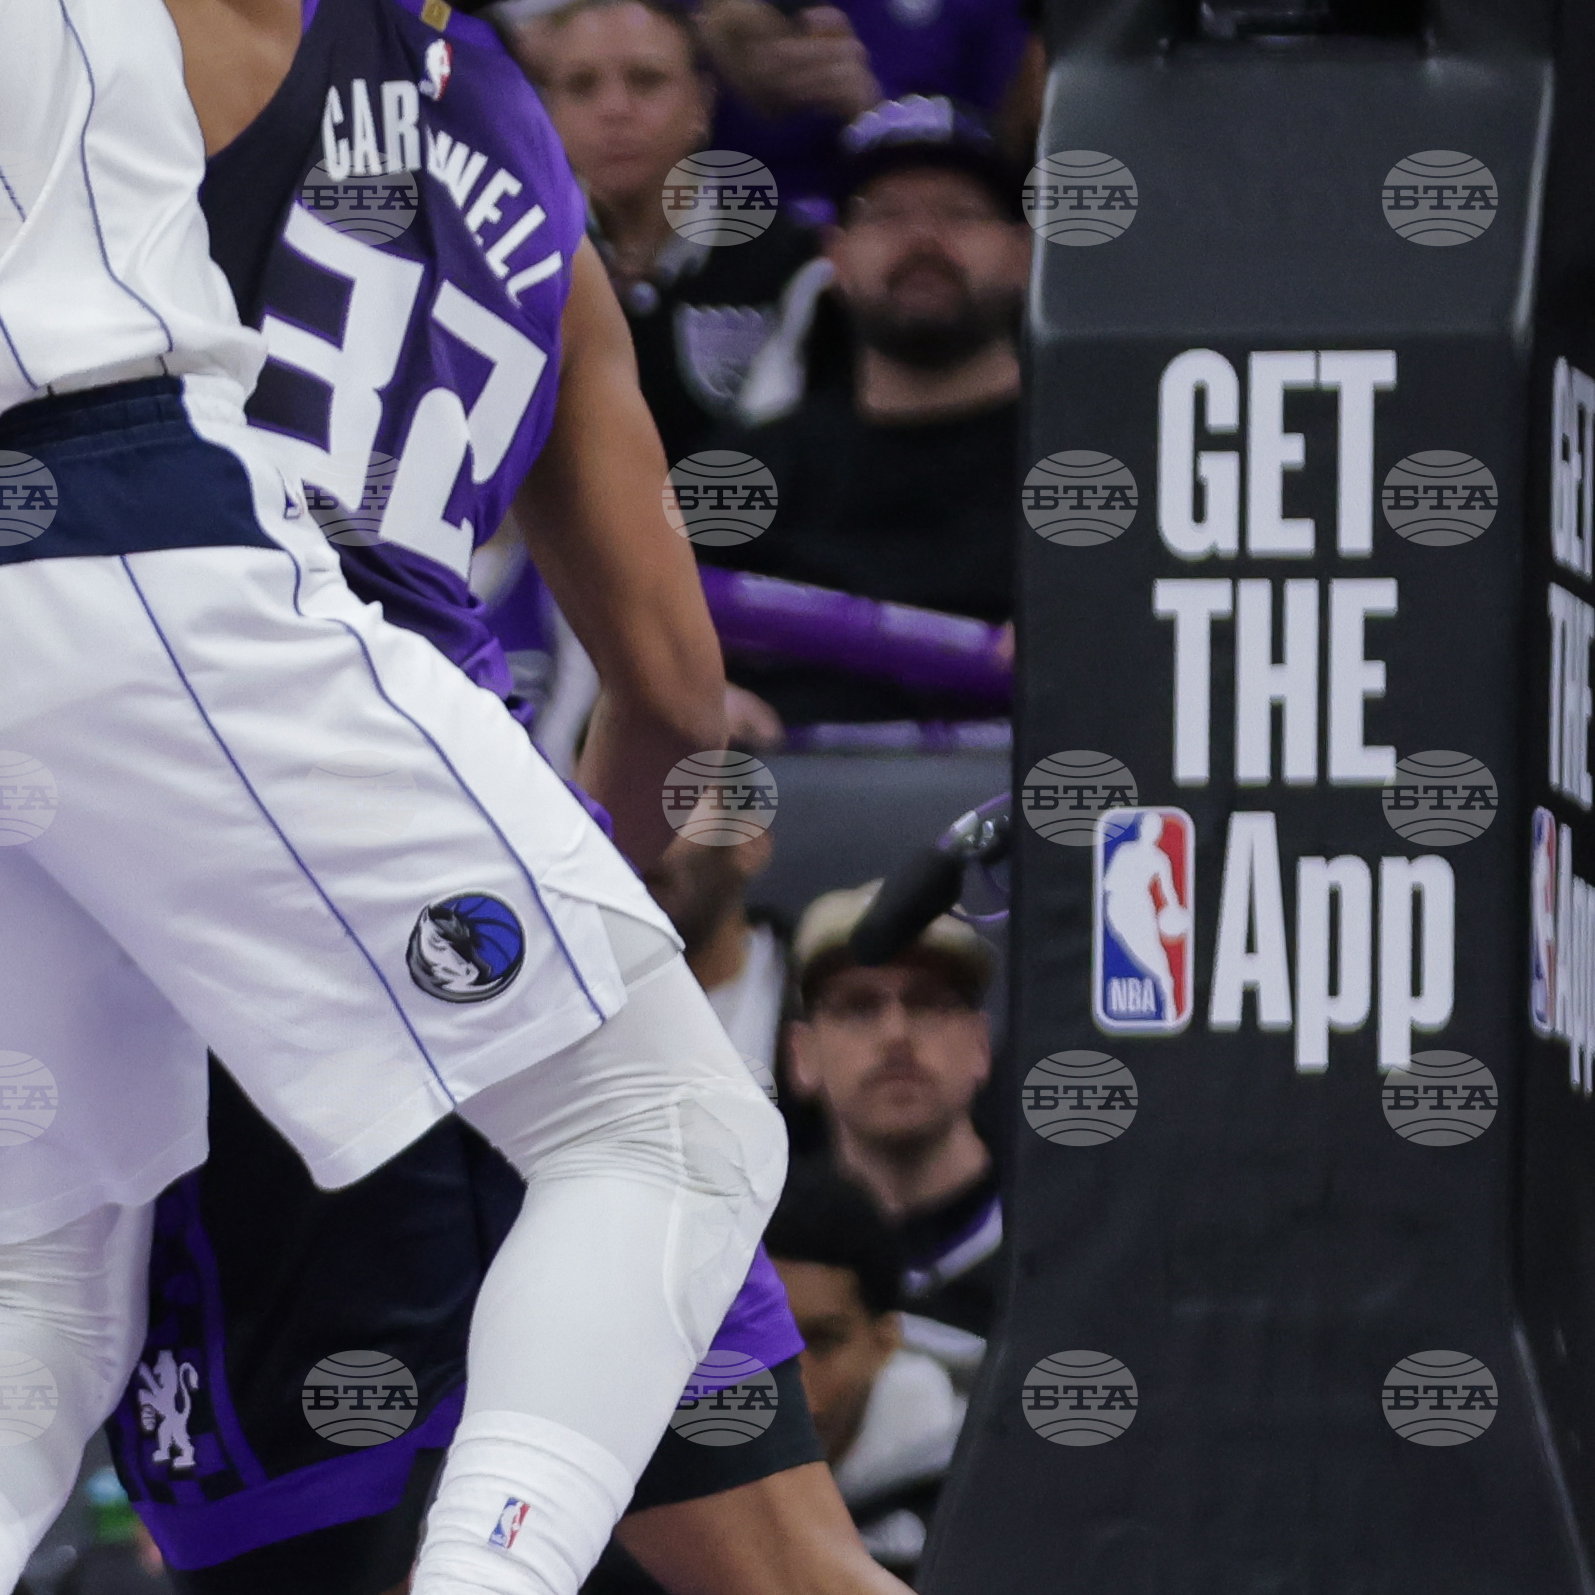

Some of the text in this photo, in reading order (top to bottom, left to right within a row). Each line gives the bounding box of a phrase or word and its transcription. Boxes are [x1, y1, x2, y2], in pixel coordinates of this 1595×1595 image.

[322, 78, 563, 309] CARWELL
[248, 200, 548, 584] 32
[1157, 347, 1398, 559] GET
[1151, 578, 1399, 787] THE
[1208, 811, 1457, 1074] App
